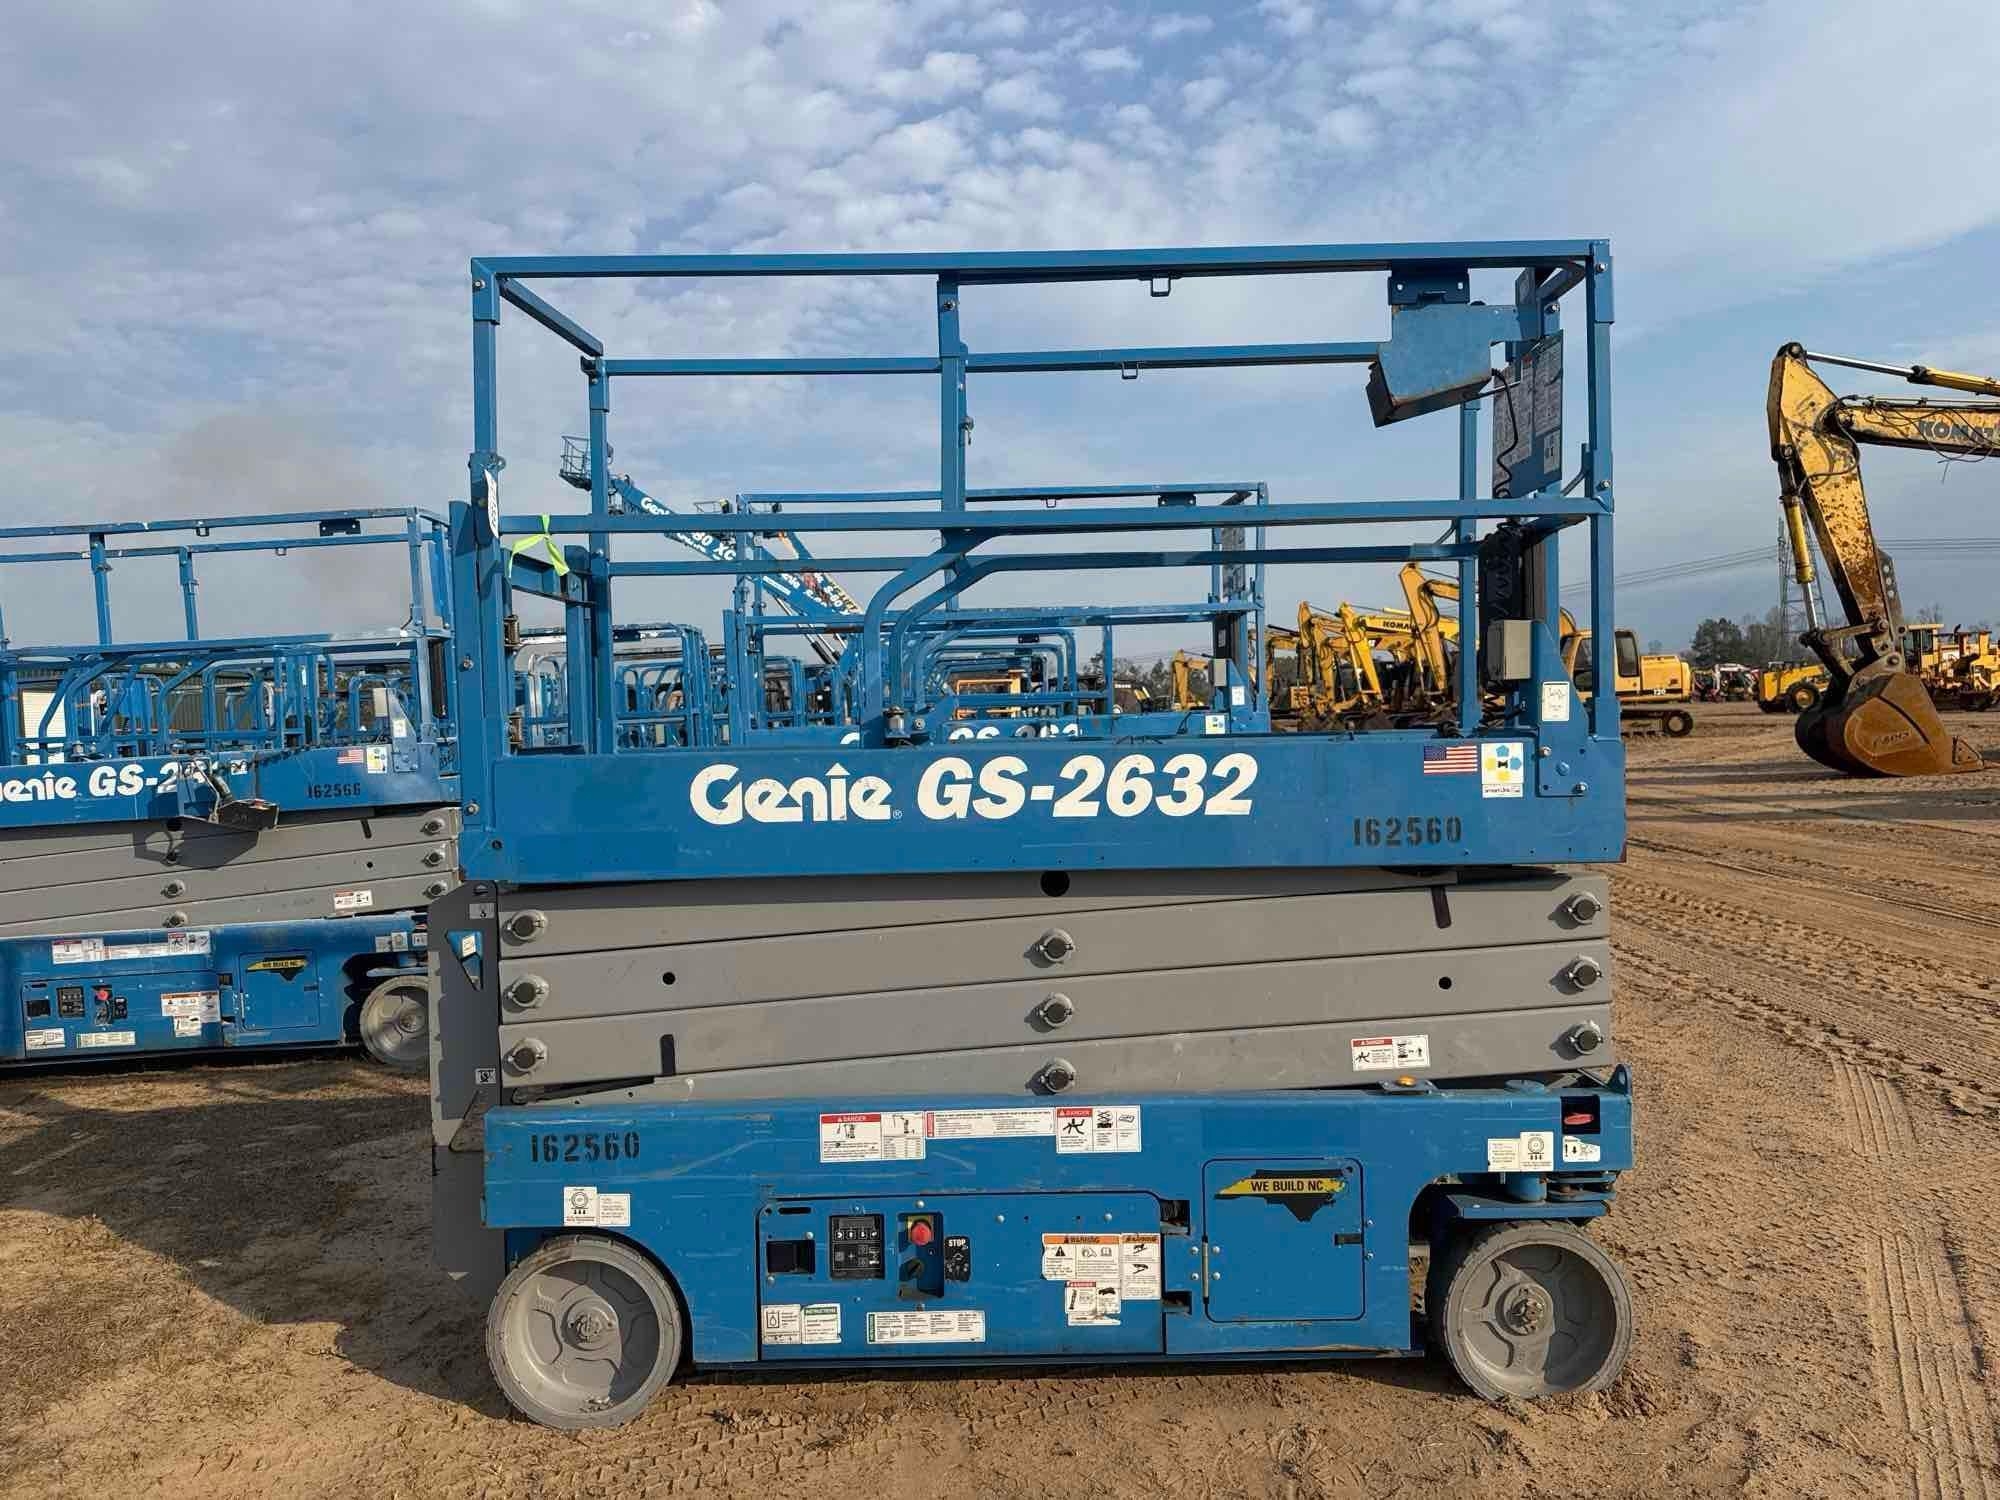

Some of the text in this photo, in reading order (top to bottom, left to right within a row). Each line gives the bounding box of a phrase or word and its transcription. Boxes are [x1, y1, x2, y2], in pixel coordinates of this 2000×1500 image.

[1919, 420, 2000, 443] KOMAT
[0, 770, 77, 802] enie
[690, 753, 1259, 825] Genie GS-2632
[1353, 816, 1462, 847] 162560
[531, 1131, 640, 1163] 162560
[1251, 1180, 1324, 1192] WE BUILD NC
[948, 1239, 966, 1247] STOP
